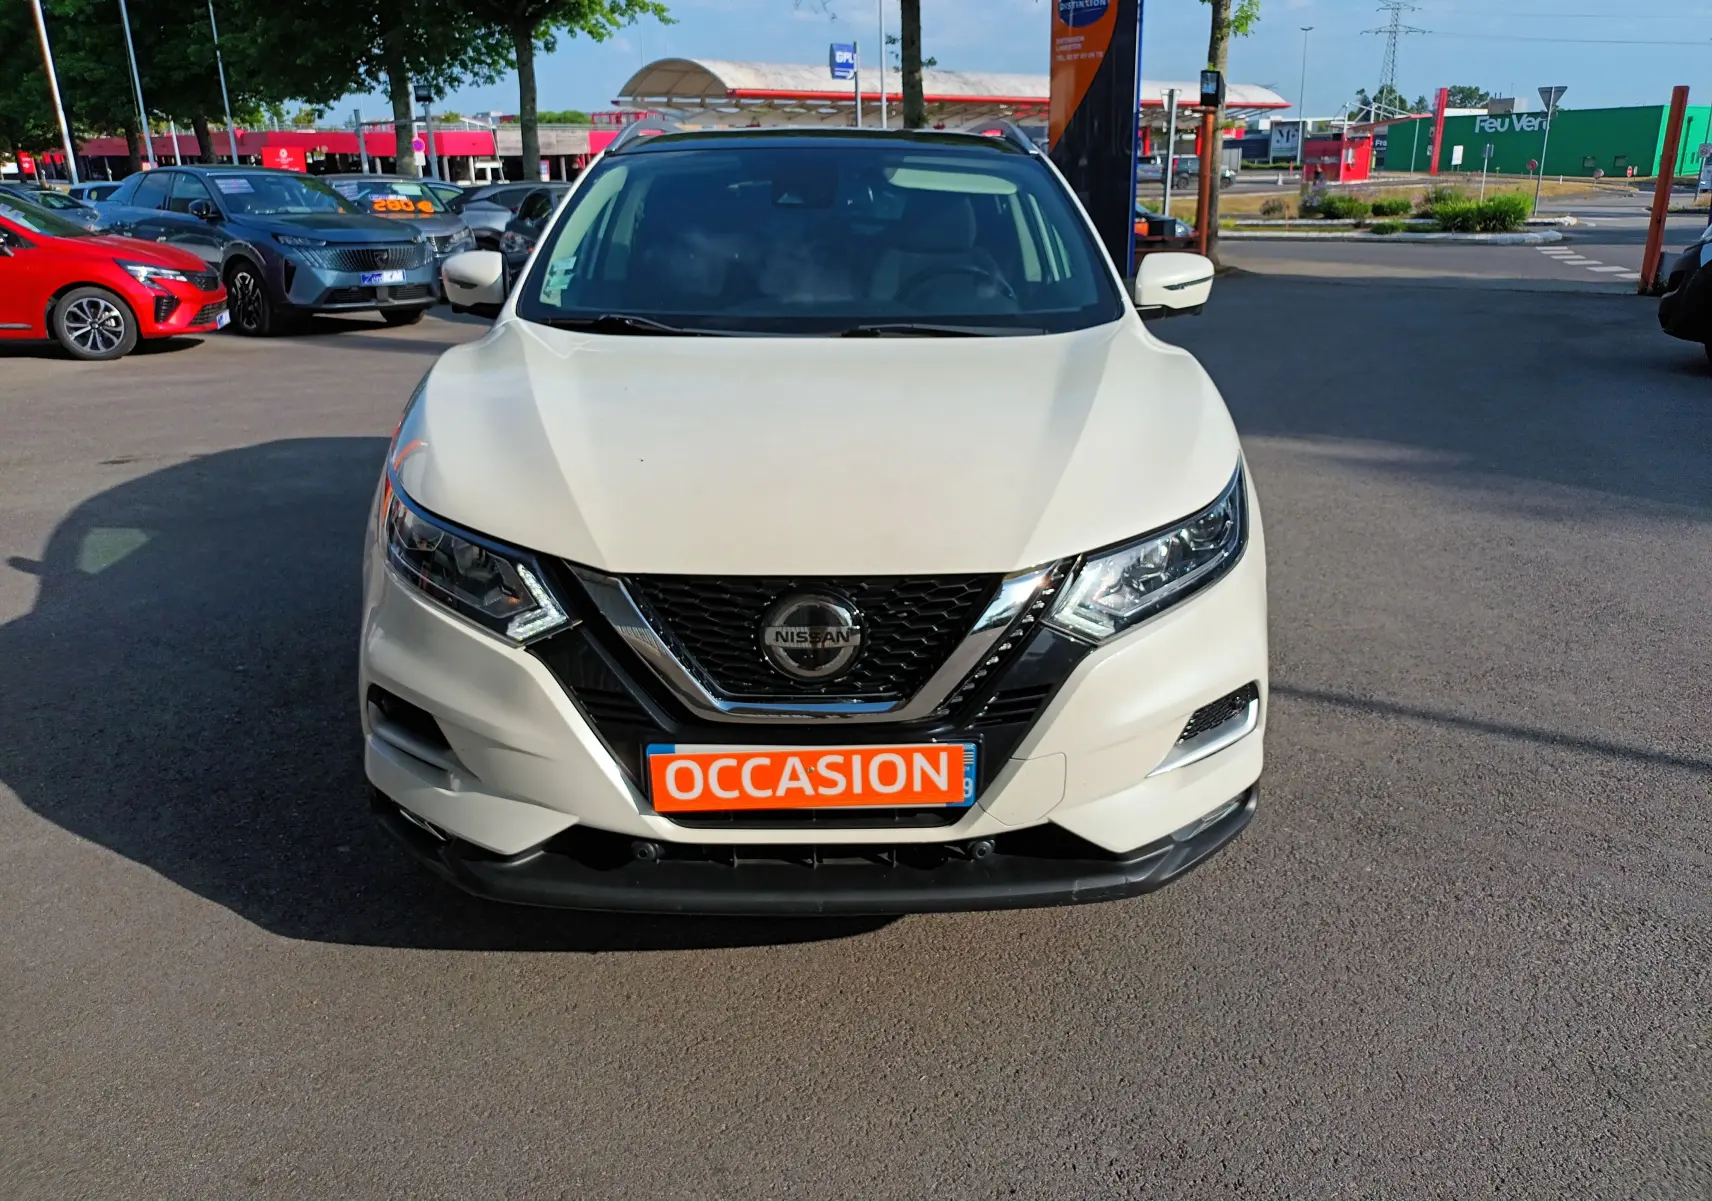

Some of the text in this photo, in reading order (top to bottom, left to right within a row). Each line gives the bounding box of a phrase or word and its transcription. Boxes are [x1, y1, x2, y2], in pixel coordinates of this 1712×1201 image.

[1474, 115, 1510, 133] Feu
[775, 631, 850, 643] NISSAN
[665, 752, 949, 800] OCCASION
[963, 776, 973, 799] 9
